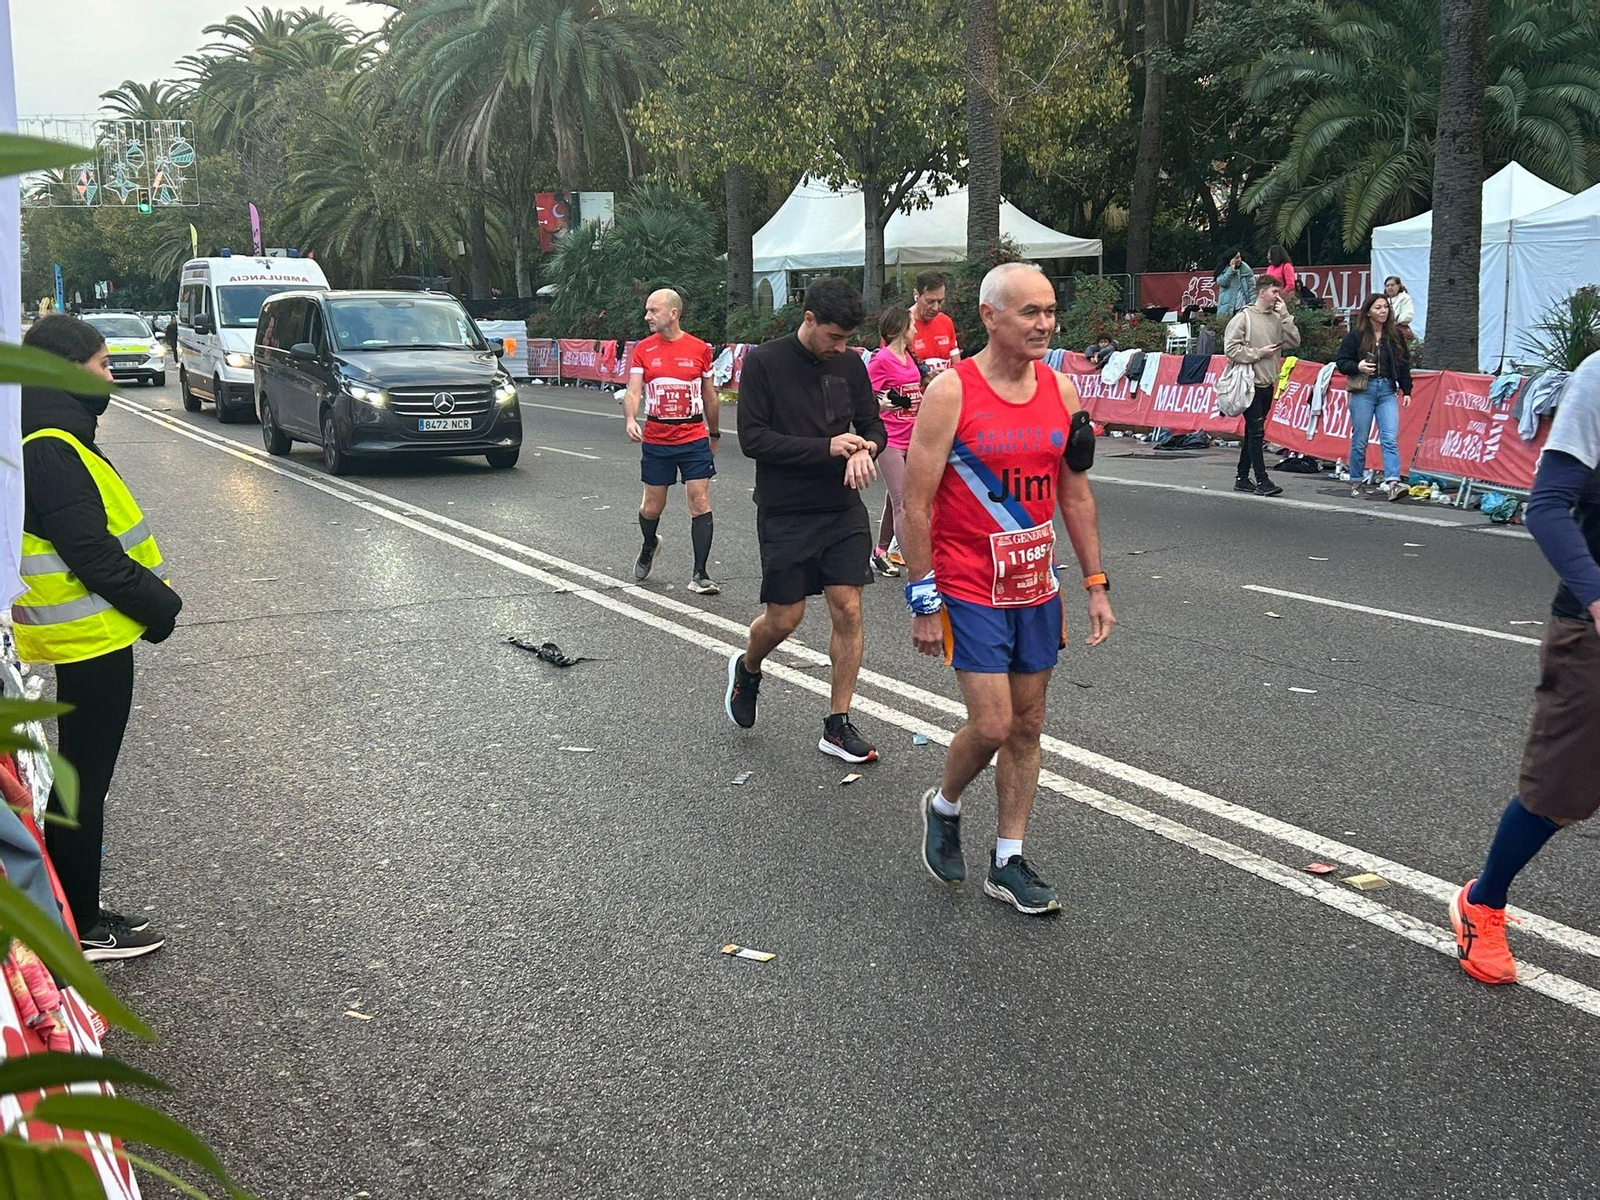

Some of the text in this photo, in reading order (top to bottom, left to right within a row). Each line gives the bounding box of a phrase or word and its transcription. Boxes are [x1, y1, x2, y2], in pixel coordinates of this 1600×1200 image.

[1067, 373, 1129, 400] NERALI
[665, 392, 680, 400] 174
[425, 420, 448, 430] 8472
[451, 420, 469, 429] NCR
[988, 468, 1051, 503] Jim
